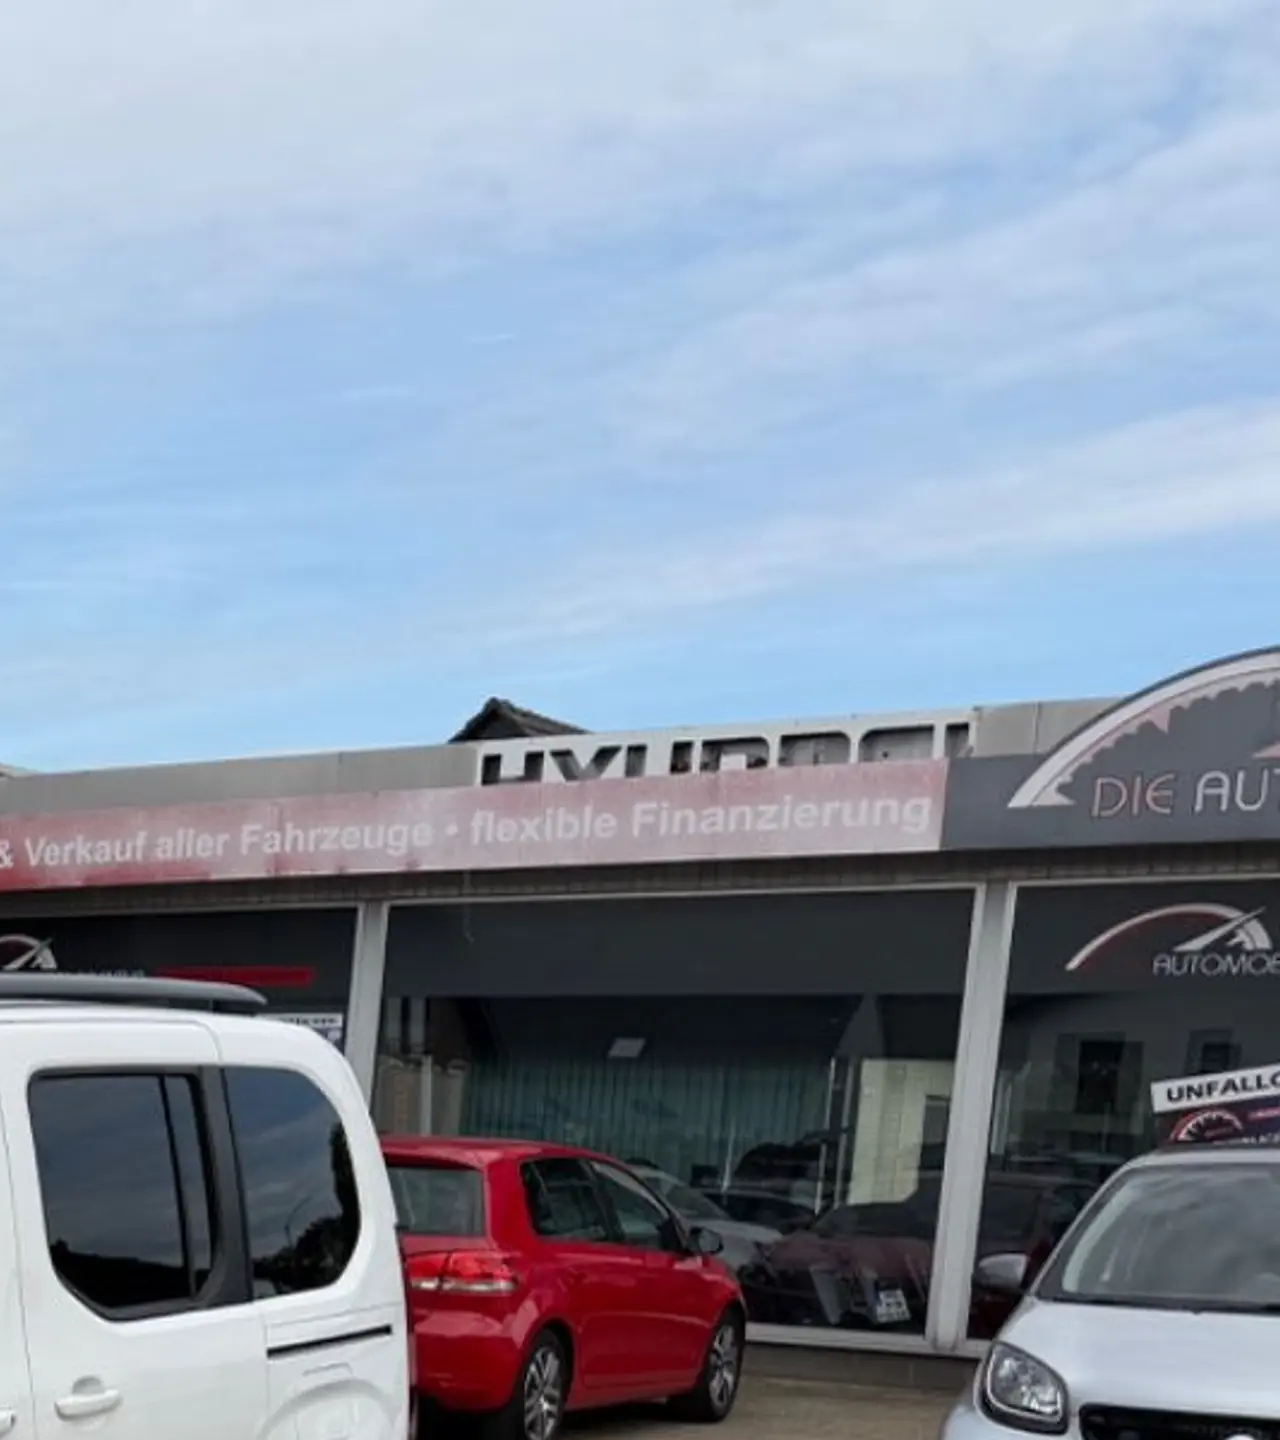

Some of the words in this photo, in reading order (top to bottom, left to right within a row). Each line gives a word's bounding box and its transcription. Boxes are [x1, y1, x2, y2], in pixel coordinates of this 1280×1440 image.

[1091, 773, 1175, 817] DIE
[24, 831, 149, 867] Verkauf
[155, 827, 230, 860] aller
[240, 821, 435, 856] Fahrzeuge
[471, 804, 617, 845] flexible
[632, 795, 933, 838] Finanzierung
